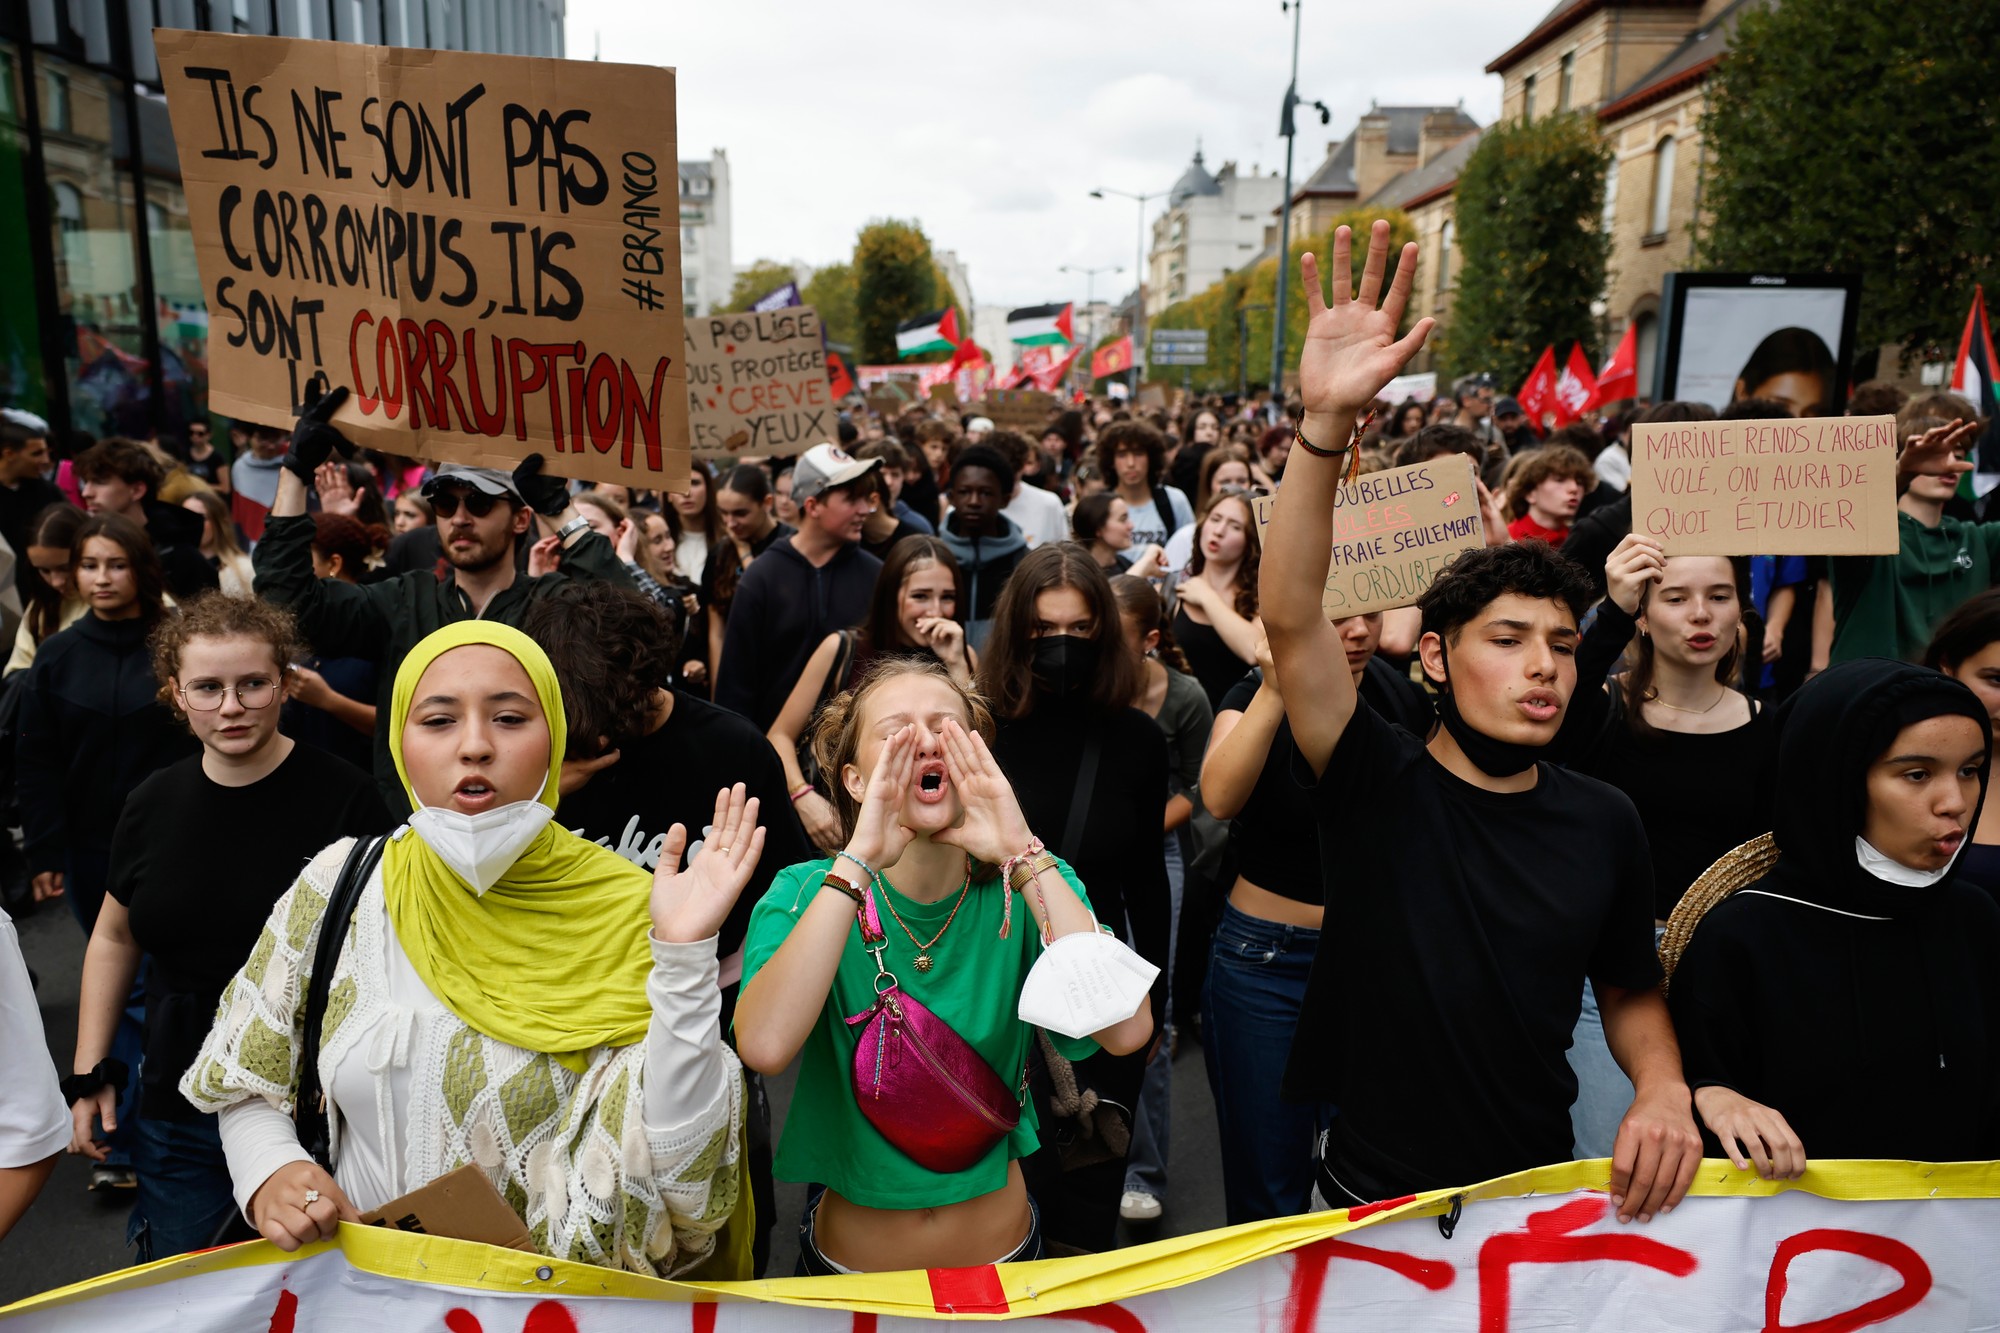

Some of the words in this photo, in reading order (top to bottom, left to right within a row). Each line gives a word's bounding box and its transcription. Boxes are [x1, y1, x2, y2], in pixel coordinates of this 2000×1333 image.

[184, 67, 277, 169] ILS
[291, 87, 352, 179] NE
[361, 83, 486, 199] SONT
[503, 103, 609, 213] PAS
[621, 151, 664, 312] #BRANCO
[217, 276, 325, 366] SONT
[728, 378, 824, 414] CRÈVE
[690, 424, 724, 450] ES
[745, 410, 828, 448] YEUX
[1745, 425, 1810, 454] RENDS
[1817, 421, 1897, 453] L'ARGENT
[1334, 469, 1434, 508] OUBELLES
[1728, 466, 1758, 493] ON
[1774, 463, 1831, 491] AURA
[1837, 463, 1868, 489] DE
[1393, 515, 1478, 553] SEULEMENT
[1646, 507, 1711, 540] QUOI
